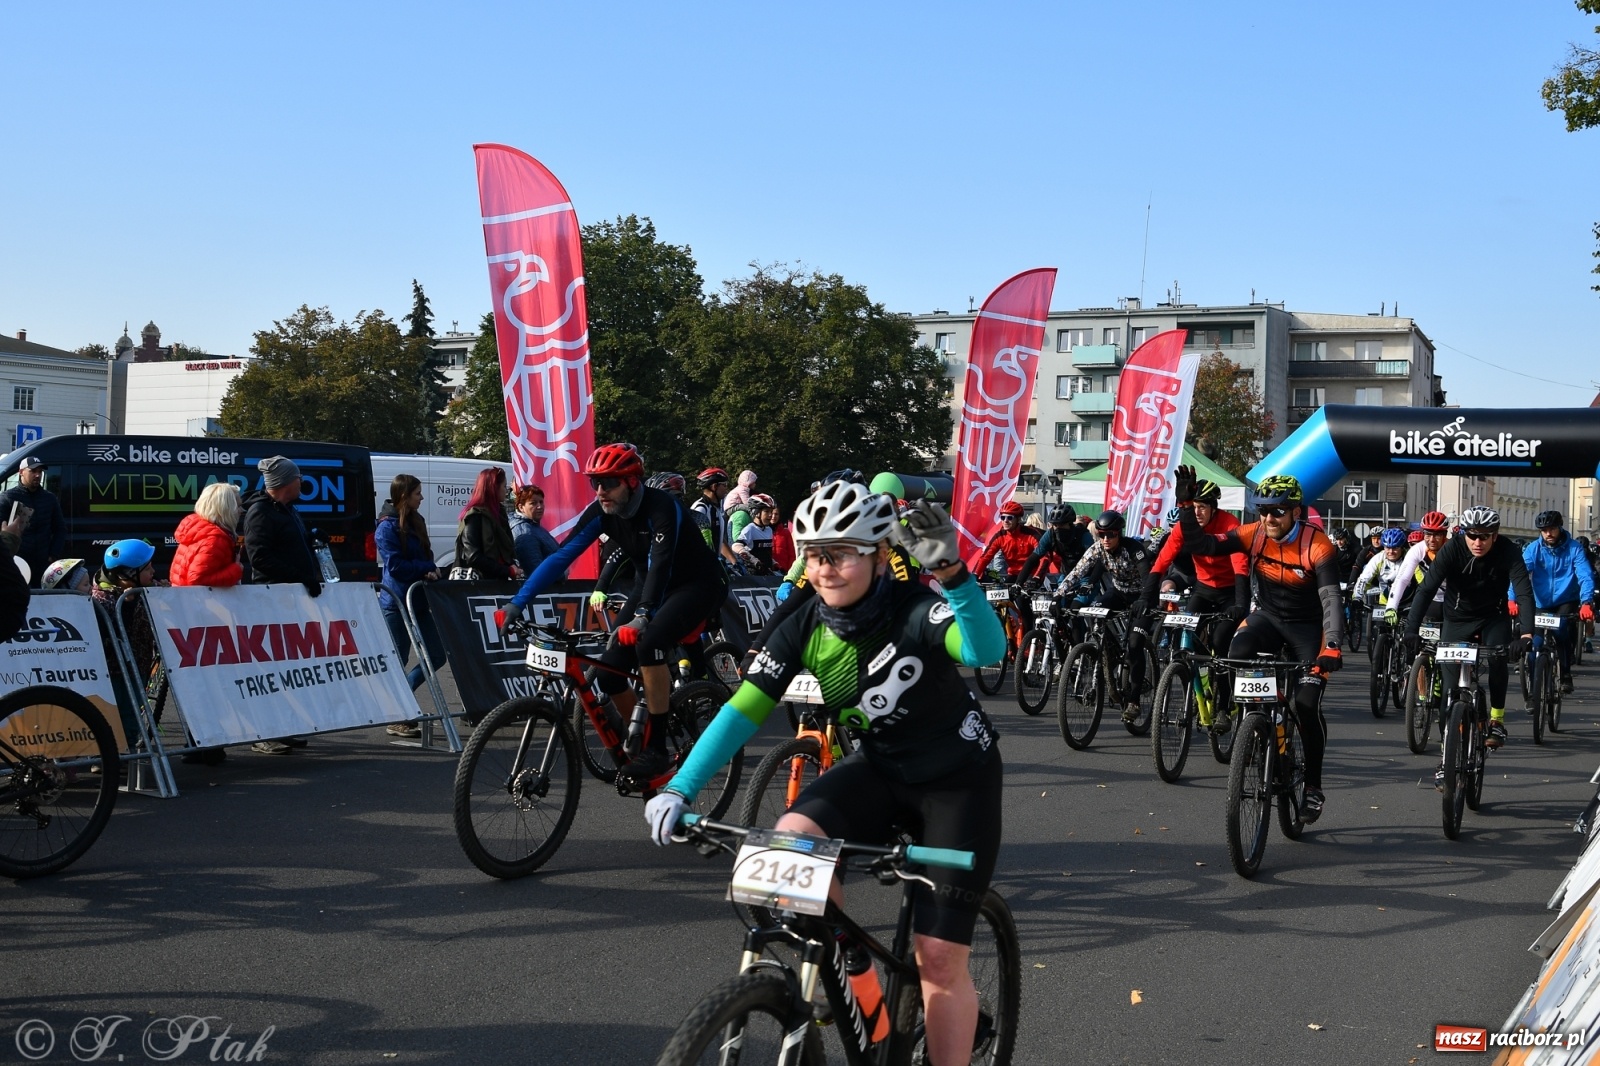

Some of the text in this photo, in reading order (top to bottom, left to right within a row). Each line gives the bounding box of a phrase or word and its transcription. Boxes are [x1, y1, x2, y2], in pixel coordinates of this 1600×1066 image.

[185, 361, 241, 371] BLACK RED WHITE
[1389, 429, 1542, 458] bike atelier
[129, 444, 238, 465] bike atelier
[990, 591, 1006, 599] 1992
[1170, 616, 1194, 625] 2339
[1537, 617, 1556, 625] 3198
[166, 619, 360, 669] YAKIMA
[8, 646, 87, 657] gdziekolwiek jedziesz
[1443, 650, 1470, 659] 1142
[531, 651, 559, 669] 1138
[235, 653, 388, 700] TAKE MORE FRIENDS
[1240, 682, 1271, 693] 2386
[747, 857, 815, 889] 2143
